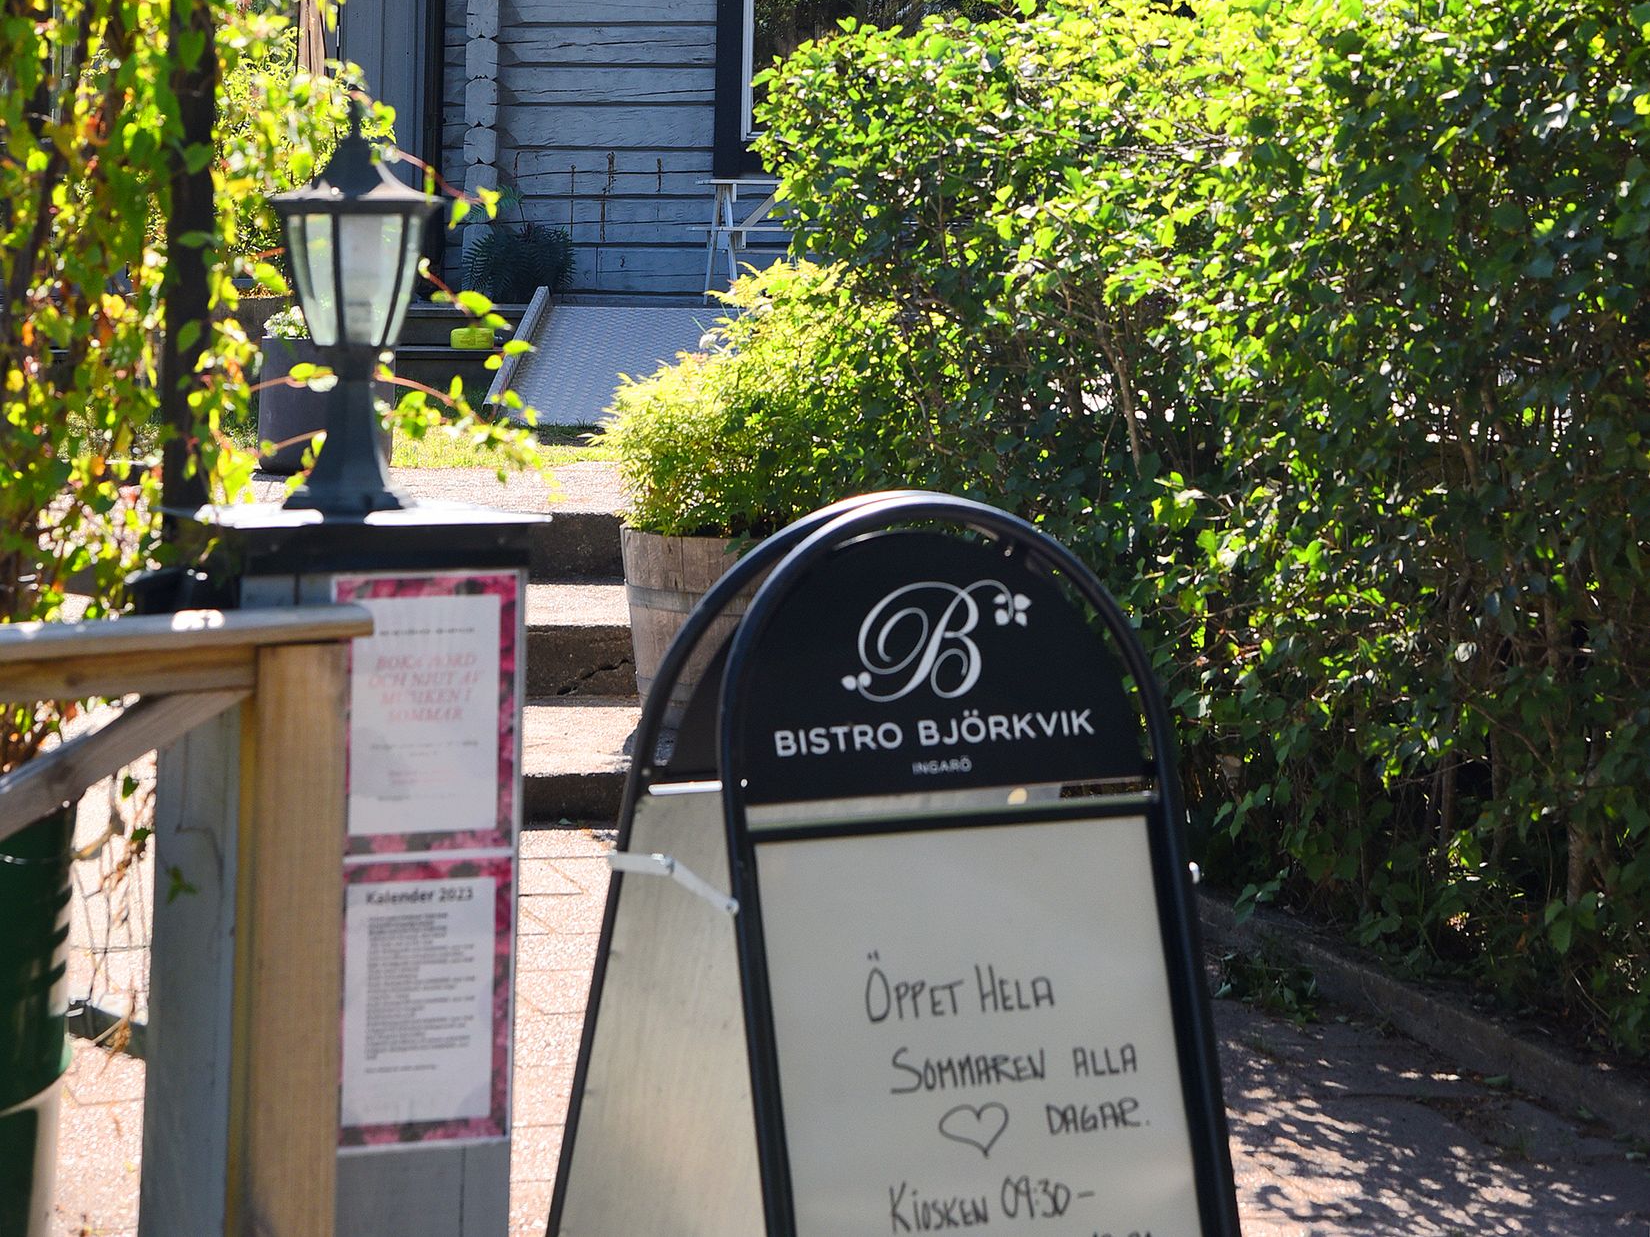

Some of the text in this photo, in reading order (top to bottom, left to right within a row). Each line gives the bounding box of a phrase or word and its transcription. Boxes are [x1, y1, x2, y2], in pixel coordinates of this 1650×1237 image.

[773, 707, 1096, 759] BISTRO BJÖRKVIK
[366, 886, 474, 905] Kalender 2023
[864, 950, 1056, 1024] ÖPPET HELA
[889, 1043, 1138, 1095] SOMMAREN ALLA
